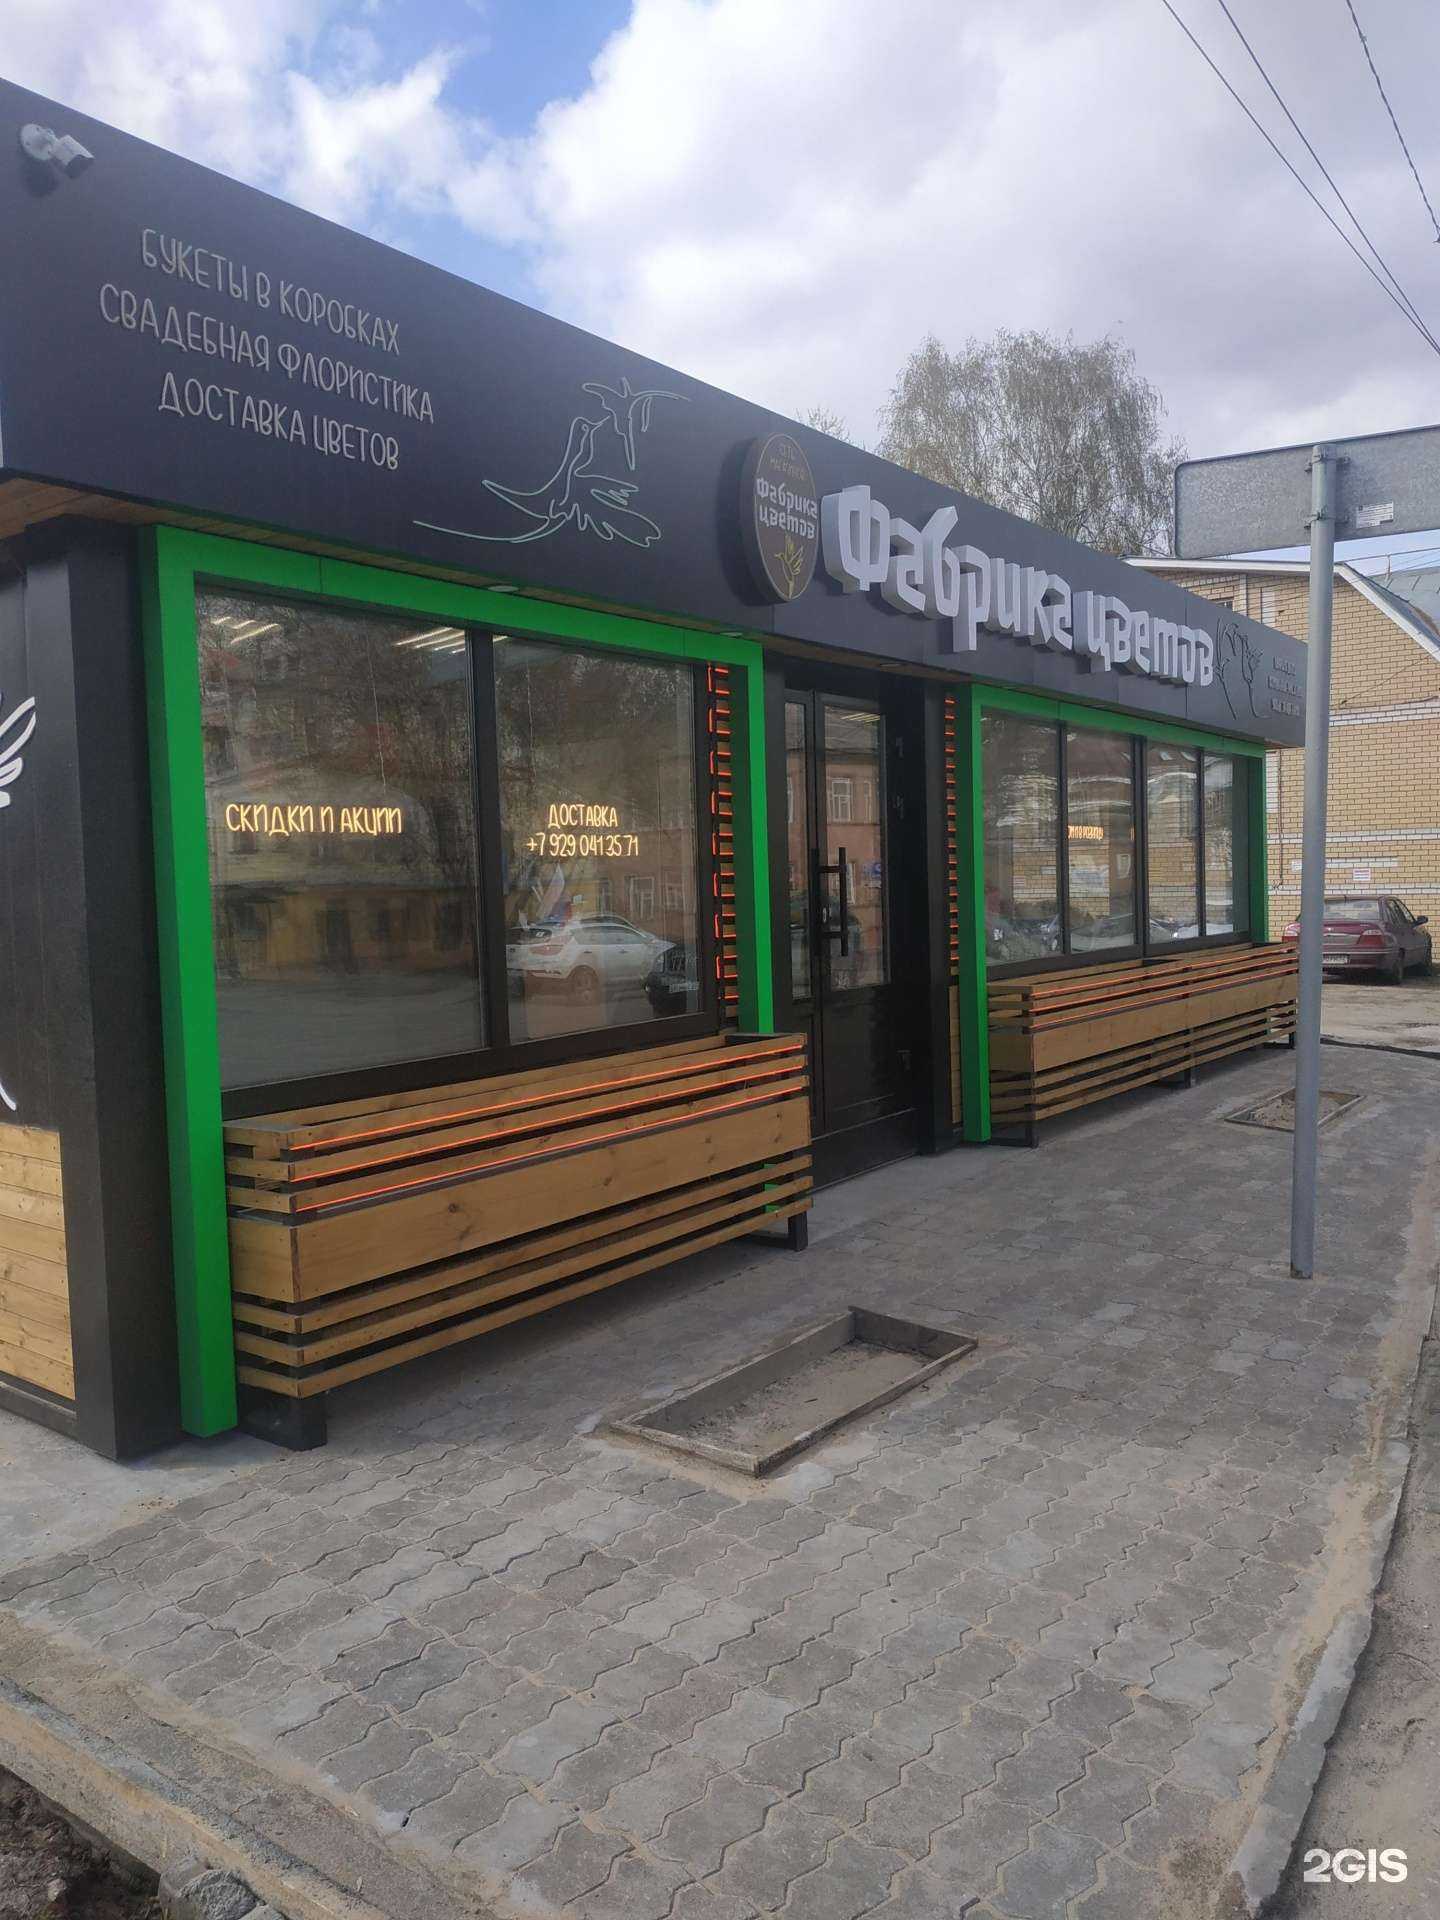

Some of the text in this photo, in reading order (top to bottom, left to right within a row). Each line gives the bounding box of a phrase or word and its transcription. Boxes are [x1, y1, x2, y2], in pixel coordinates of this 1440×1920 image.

[142, 228, 400, 356] БУКЕТЫ В КОРОБКАХ
[99, 283, 435, 424] СВАДЕБНАЯ ФЛОРИСТИКА
[158, 371, 400, 470] ДОСТАВКА ЦВЕТОВ
[756, 476, 818, 519] Фабрика
[821, 484, 1214, 687] Фабрика цветов
[225, 803, 402, 837] СКИДКИ И АКЦИИ
[547, 803, 618, 830] ДОСТАВКА
[549, 833, 576, 857] 929
